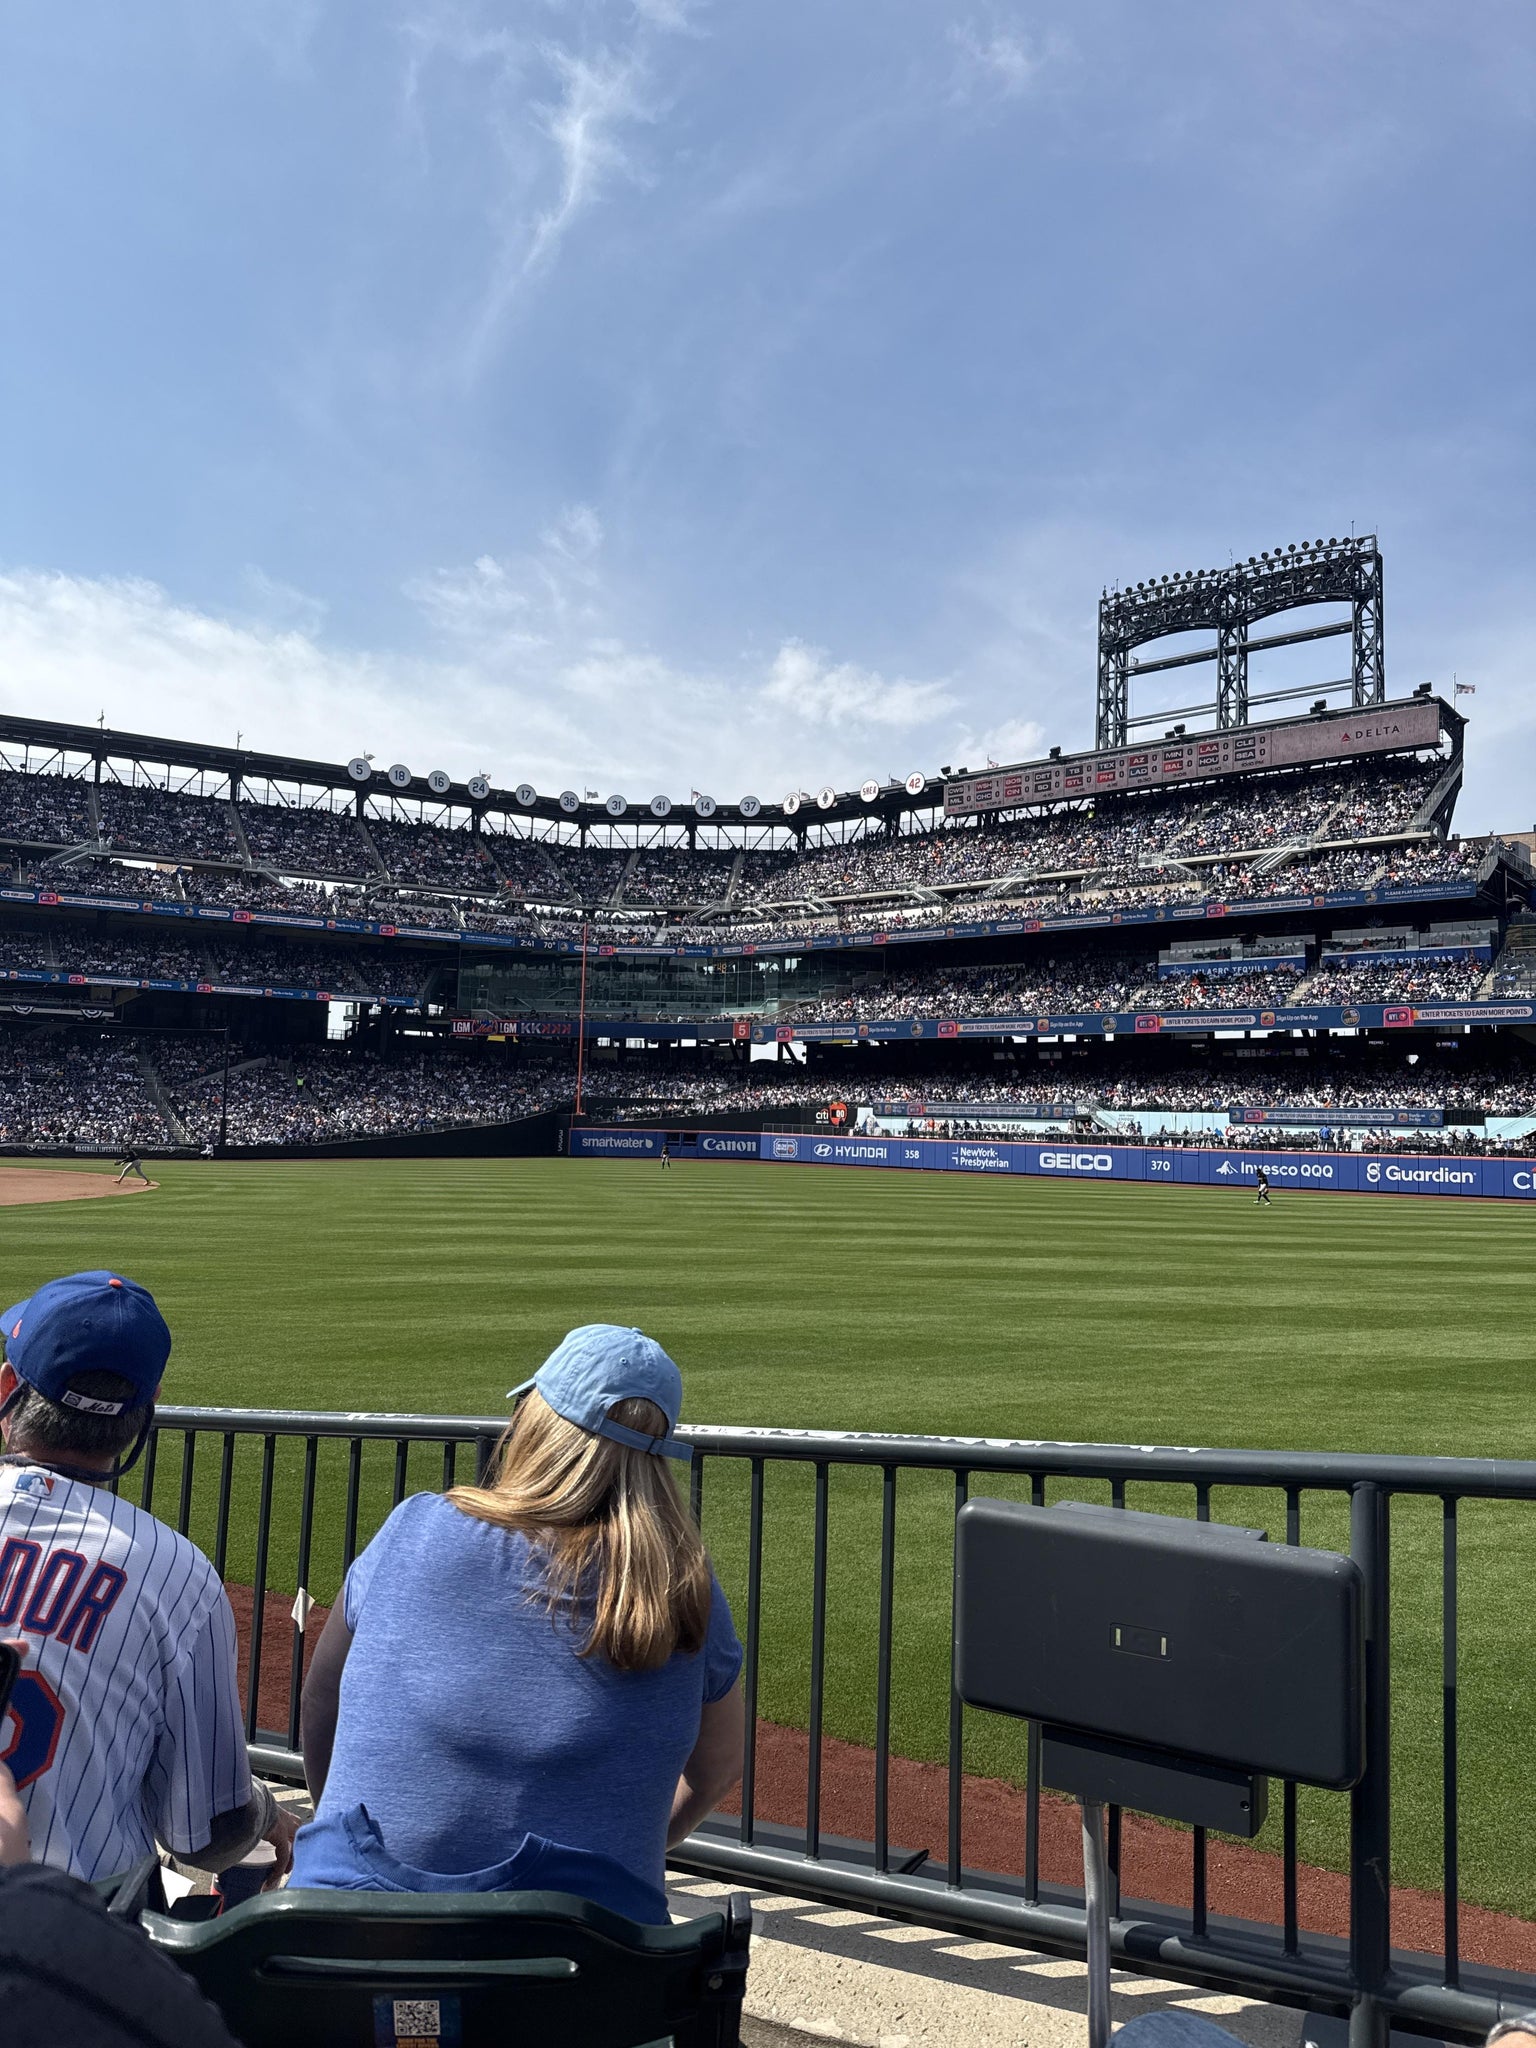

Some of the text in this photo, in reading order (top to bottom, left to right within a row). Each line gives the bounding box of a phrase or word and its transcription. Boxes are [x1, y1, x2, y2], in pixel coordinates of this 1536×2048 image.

[1355, 725, 1400, 739] DELTA
[1236, 739, 1254, 747] CLE
[1200, 745, 1218, 753] LAA
[1165, 751, 1181, 759] MIN
[1099, 761, 1115, 769] TEX
[1199, 757, 1218, 765] HOU
[356, 764, 363, 775] 5
[1164, 763, 1182, 771] BAL
[395, 770, 405, 781] 18
[1035, 772, 1051, 780] DET
[434, 777, 444, 787] 16
[909, 778, 921, 789] 42
[1005, 777, 1021, 785] BOS
[472, 782, 485, 794] 24
[863, 786, 877, 796] SHEA
[949, 787, 963, 795] CWS
[1006, 788, 1020, 796] CIN
[521, 790, 531, 801] 17
[976, 792, 992, 800] CHC
[564, 796, 575, 807] 36
[611, 801, 621, 811] 31
[656, 801, 666, 811] 41
[700, 802, 710, 812] 14
[744, 802, 756, 812] 37
[520, 939, 534, 947] 2:41
[1421, 1010, 1440, 1018] ENTER
[1488, 1008, 1505, 1016] MORE
[452, 1021, 470, 1033] LGM
[500, 1022, 517, 1034] LGM
[738, 1024, 746, 1036] 5
[815, 1110, 829, 1120] citi
[582, 1136, 645, 1149] smartwater
[703, 1138, 756, 1151] Canon
[835, 1145, 887, 1159] HYUNDAI
[904, 1150, 920, 1159] 358
[960, 1146, 998, 1158] NewYork-
[960, 1157, 1009, 1169] Presbyterian
[1039, 1152, 1112, 1171] GEICO
[1151, 1160, 1171, 1172] 370
[1240, 1161, 1333, 1178] Invesco QQQ
[1386, 1165, 1474, 1184] Guardian
[84, 1402, 116, 1414] Mets
